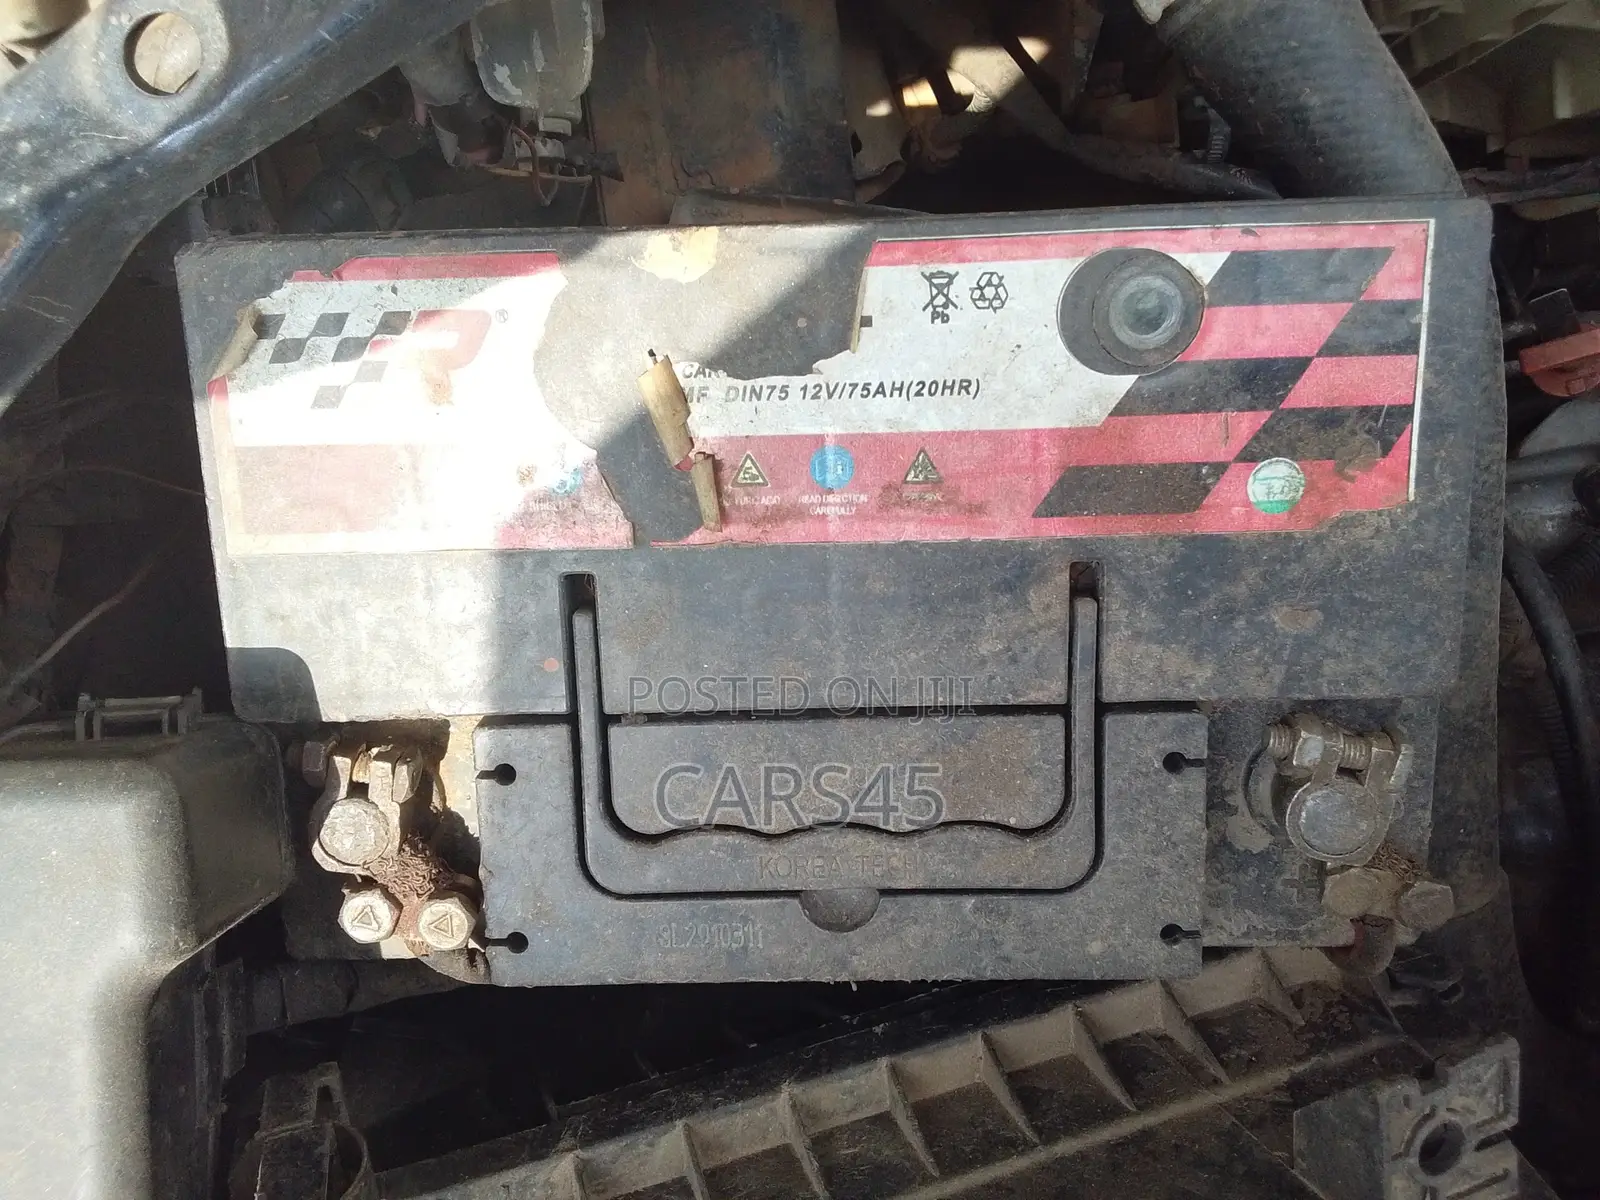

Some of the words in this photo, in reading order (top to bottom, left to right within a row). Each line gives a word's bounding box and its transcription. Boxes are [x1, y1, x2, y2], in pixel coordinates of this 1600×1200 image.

[930, 310, 950, 325] Pb
[723, 383, 790, 402] DIN75
[798, 378, 981, 400] 12V/75AH(20HR)
[759, 855, 843, 880] KOREA
[857, 854, 921, 879] TECH
